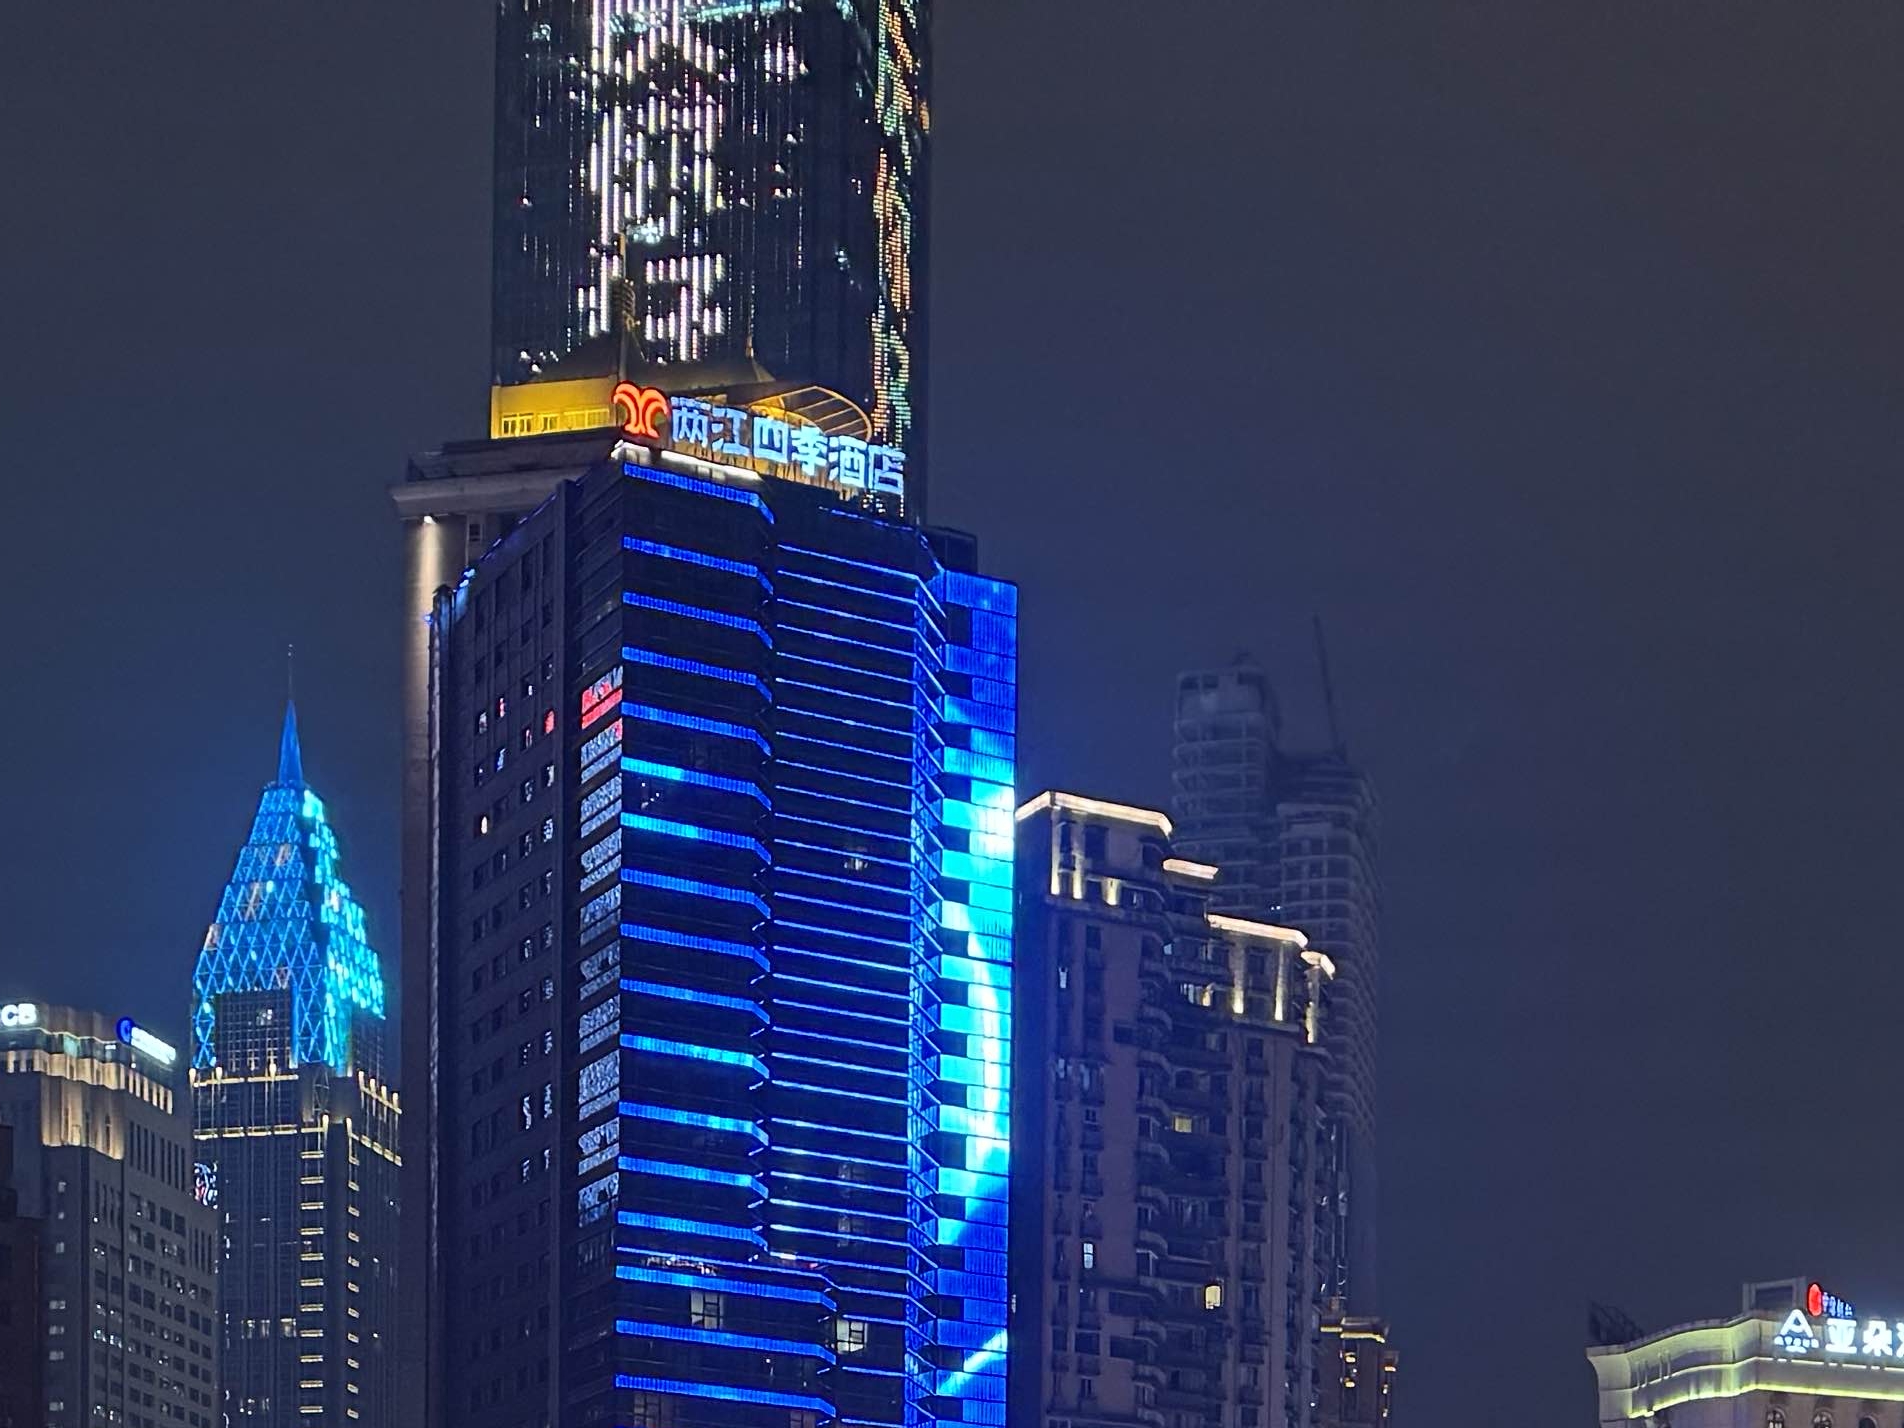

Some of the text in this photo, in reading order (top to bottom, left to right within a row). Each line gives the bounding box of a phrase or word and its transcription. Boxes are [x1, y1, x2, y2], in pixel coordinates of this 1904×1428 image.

[669, 396, 907, 495] 两江四季酒店
